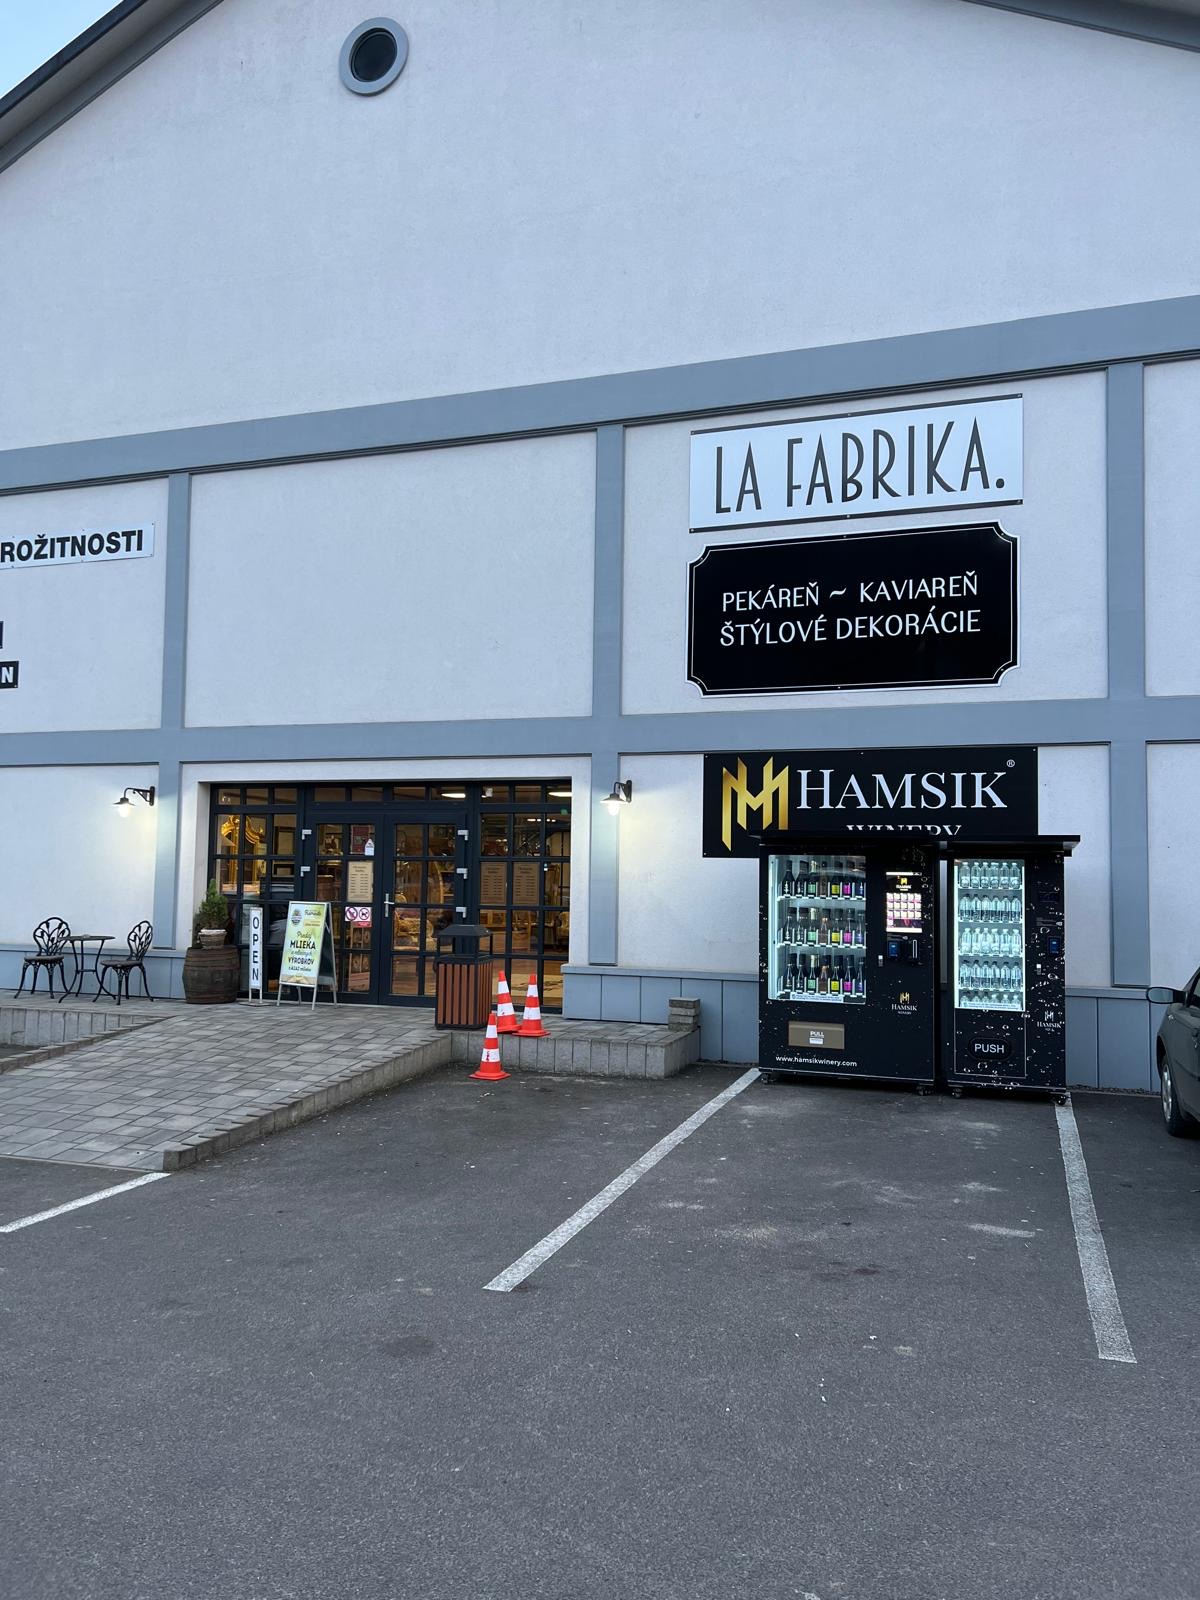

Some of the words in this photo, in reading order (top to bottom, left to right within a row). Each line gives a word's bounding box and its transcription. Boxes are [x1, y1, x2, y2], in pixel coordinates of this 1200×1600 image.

[715, 441, 762, 514] LA
[786, 416, 1005, 507] FABRIKA.
[0, 529, 143, 563] ROŽITNOSTI
[722, 582, 819, 612] PEKÁREŇ
[859, 570, 978, 603] KAVIAREŇ
[720, 615, 827, 647] ŠTÝLOVÉ
[836, 605, 981, 640] DEKORÁCIE
[796, 769, 1008, 809] HAMSIK
[252, 916, 260, 981] OPEN
[290, 940, 316, 950] MLIEKA
[891, 1003, 918, 1011] HAMSIK
[775, 1056, 858, 1068] www.hamsikwinery.com
[974, 1043, 1005, 1054] PUSH
